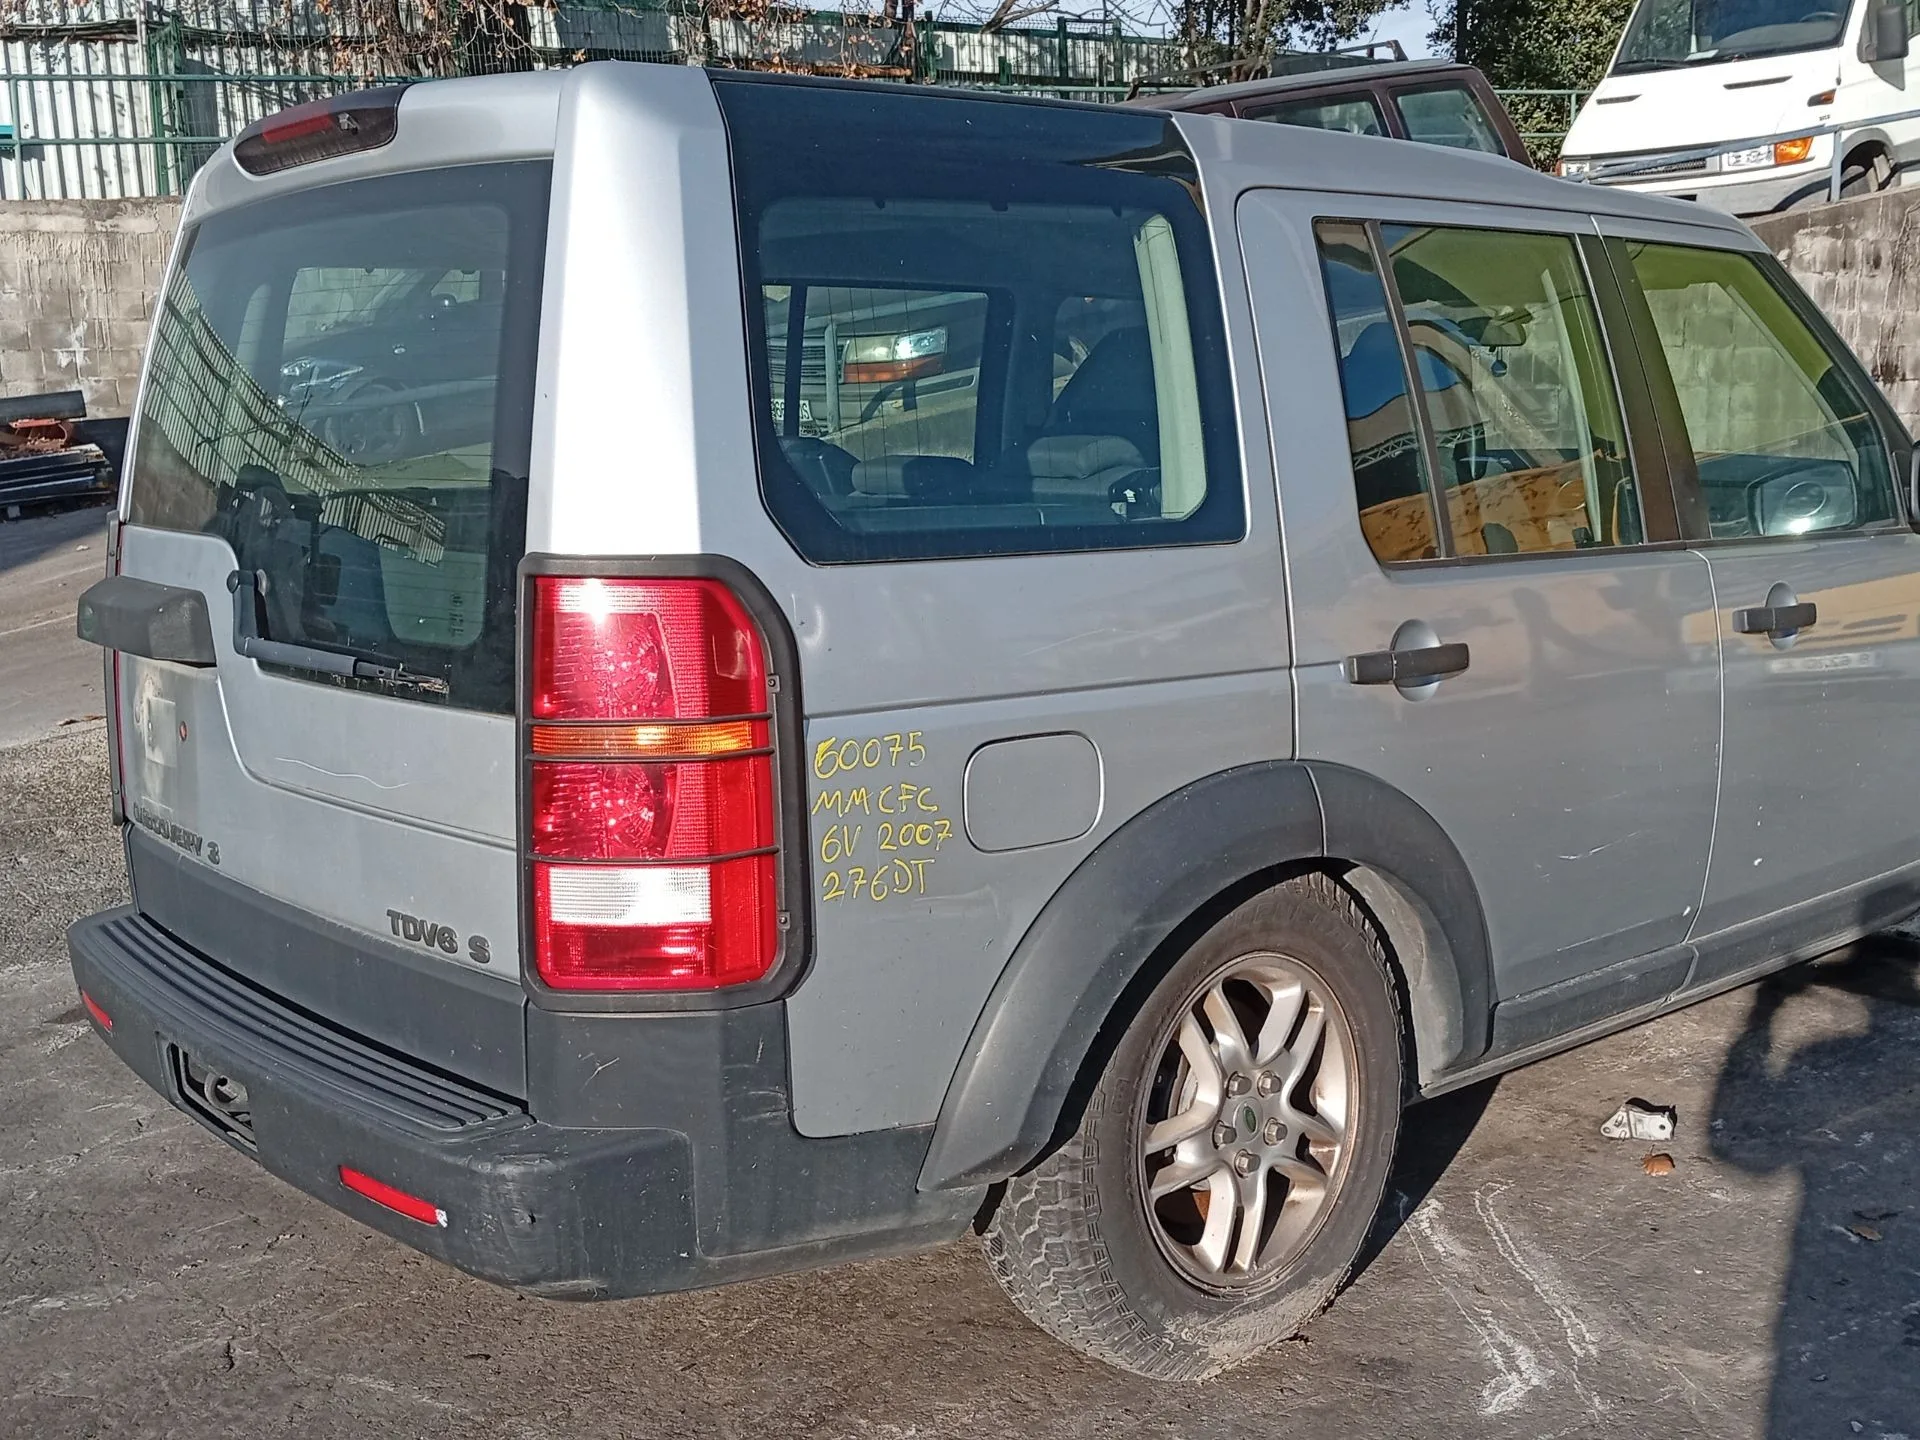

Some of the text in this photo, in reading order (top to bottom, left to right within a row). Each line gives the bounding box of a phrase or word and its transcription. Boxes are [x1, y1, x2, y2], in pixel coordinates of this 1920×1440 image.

[814, 731, 926, 779] 60075
[207, 841, 220, 865] 3
[821, 819, 953, 863] 6V 2007
[823, 858, 935, 901] 276DT
[386, 909, 491, 964] TDV6 S
